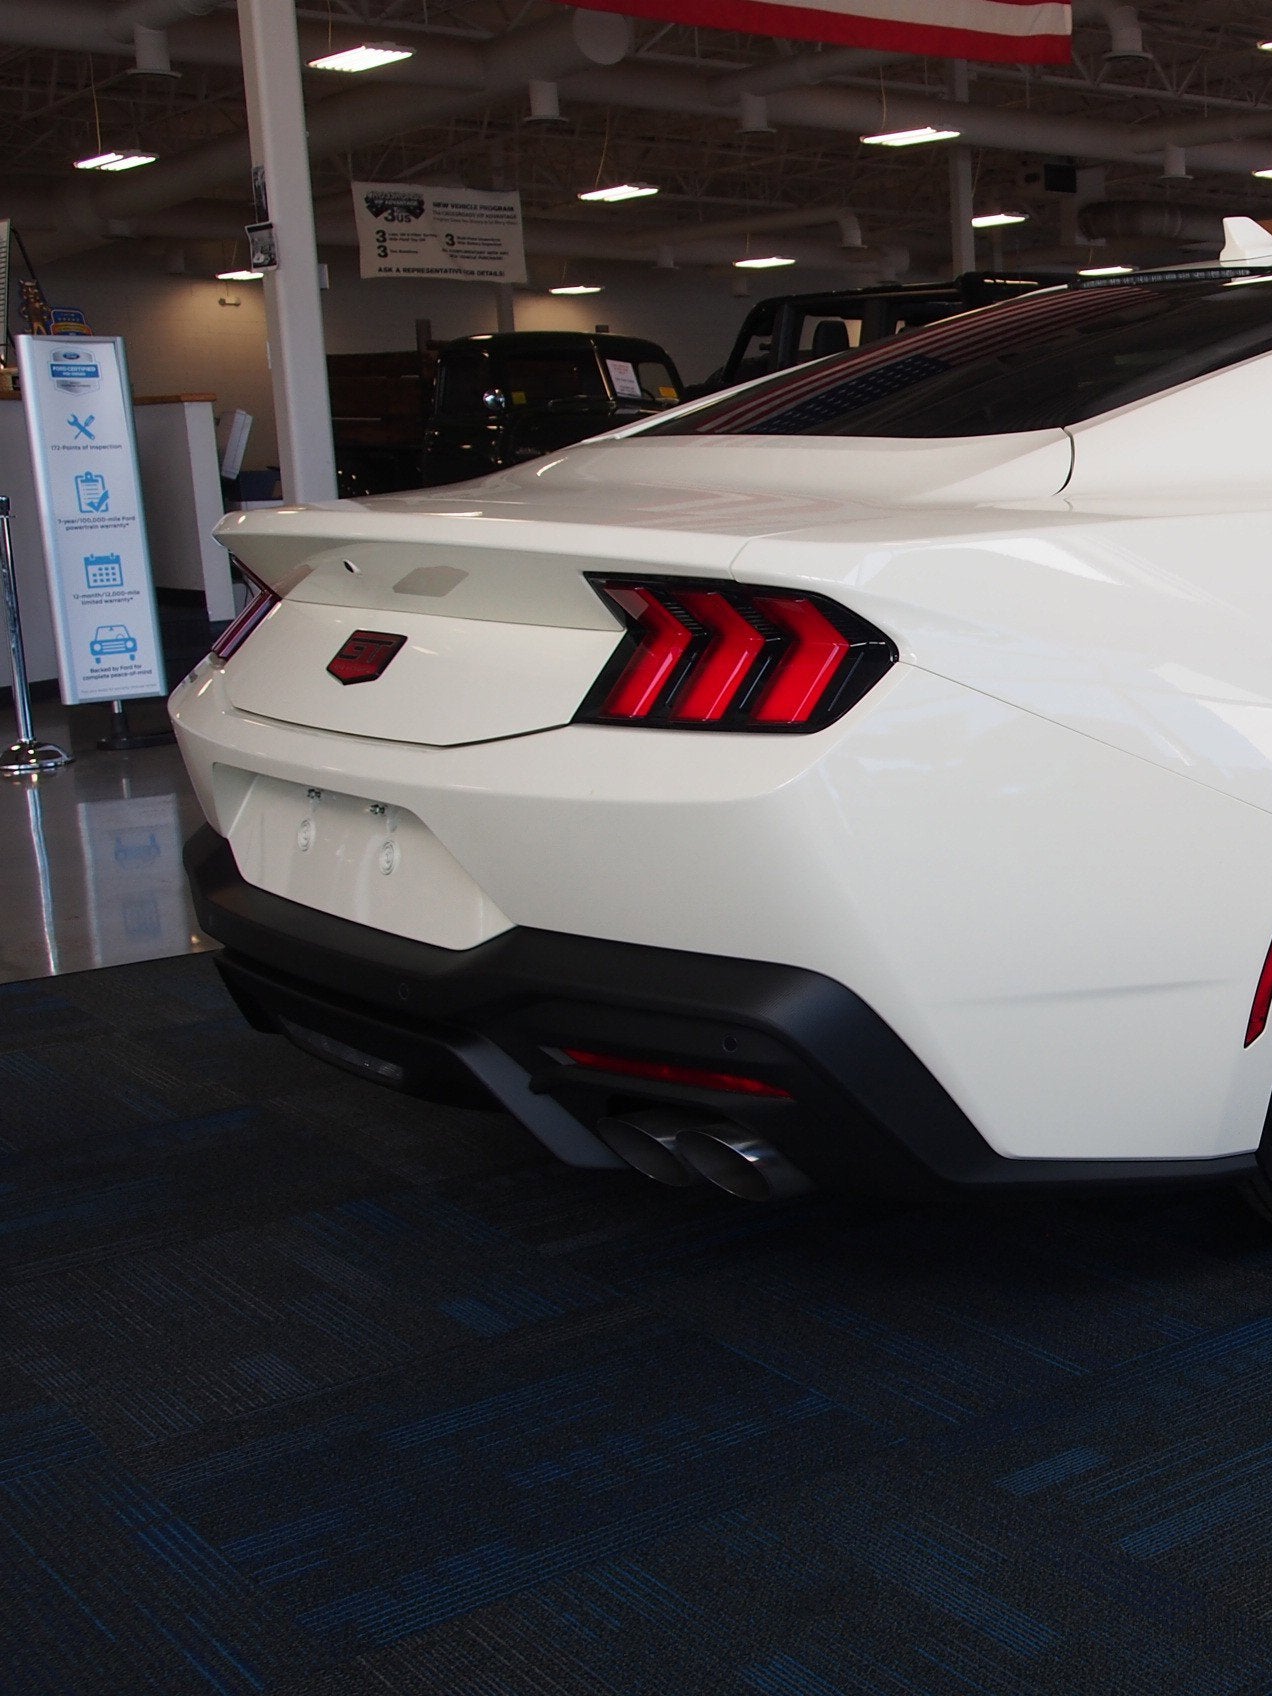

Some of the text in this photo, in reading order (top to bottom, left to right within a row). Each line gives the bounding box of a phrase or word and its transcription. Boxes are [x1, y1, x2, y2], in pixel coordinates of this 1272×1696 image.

[384, 207, 396, 223] 3
[375, 229, 387, 243] 3
[445, 233, 456, 247] 3
[377, 245, 389, 258] 3
[73, 590, 140, 600] 12-month/12,000-mile
[336, 638, 397, 663] GT
[90, 666, 112, 674] Backed
[82, 673, 110, 681] complete
